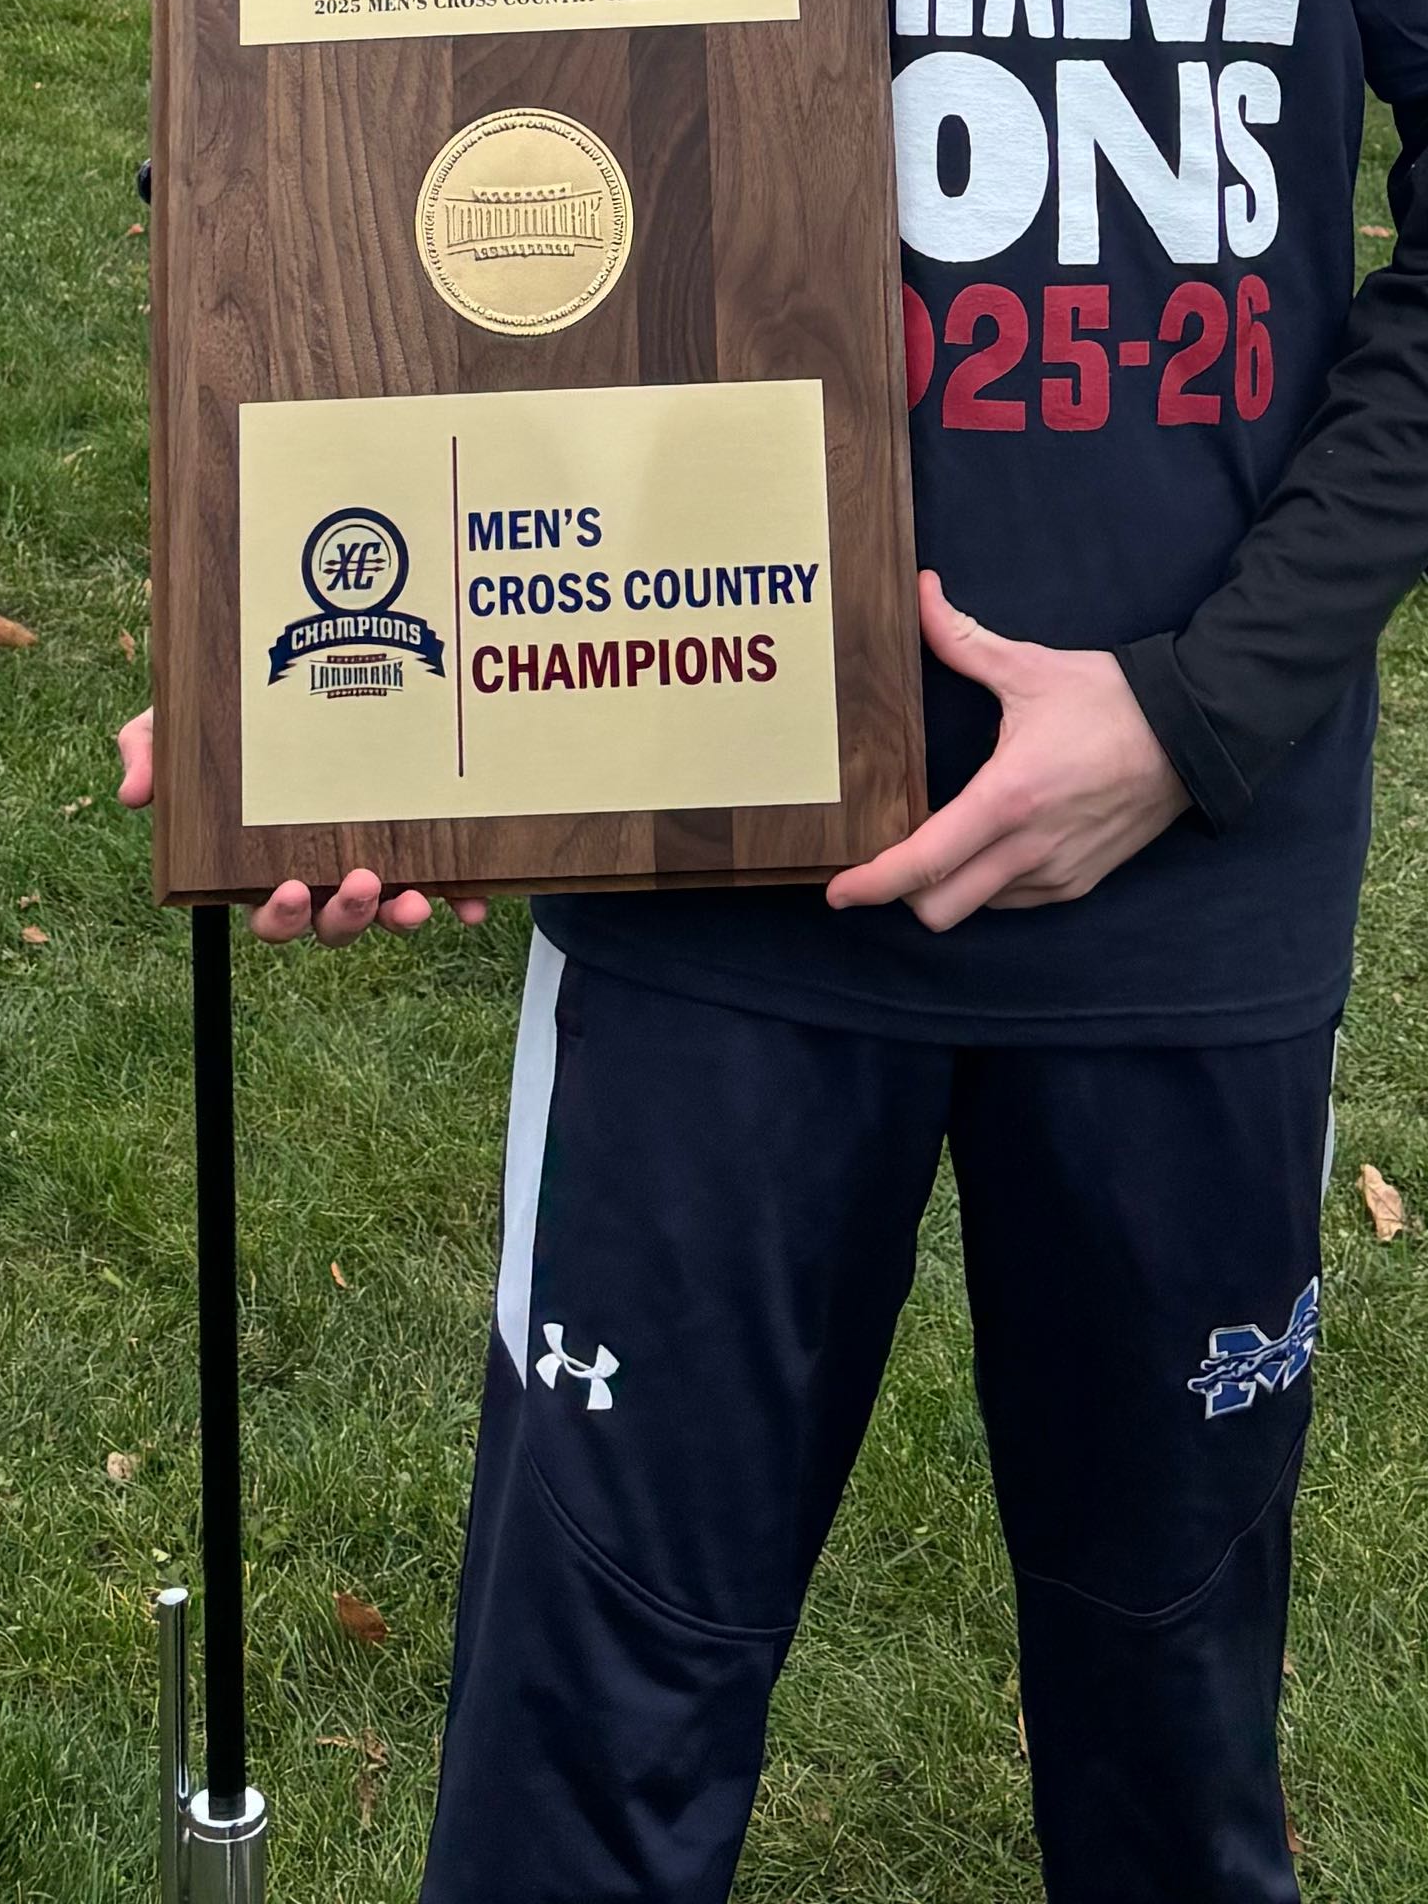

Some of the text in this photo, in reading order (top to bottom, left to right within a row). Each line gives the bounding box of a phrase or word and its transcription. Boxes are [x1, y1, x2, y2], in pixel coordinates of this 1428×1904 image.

[468, 507, 603, 552] MEN'S
[326, 542, 383, 592] XC
[469, 563, 820, 617] CROSS COUNTRY
[290, 615, 423, 652] CHAMPIONS
[310, 660, 404, 692] LANDMARK
[471, 634, 778, 694] CHAMPIONS
